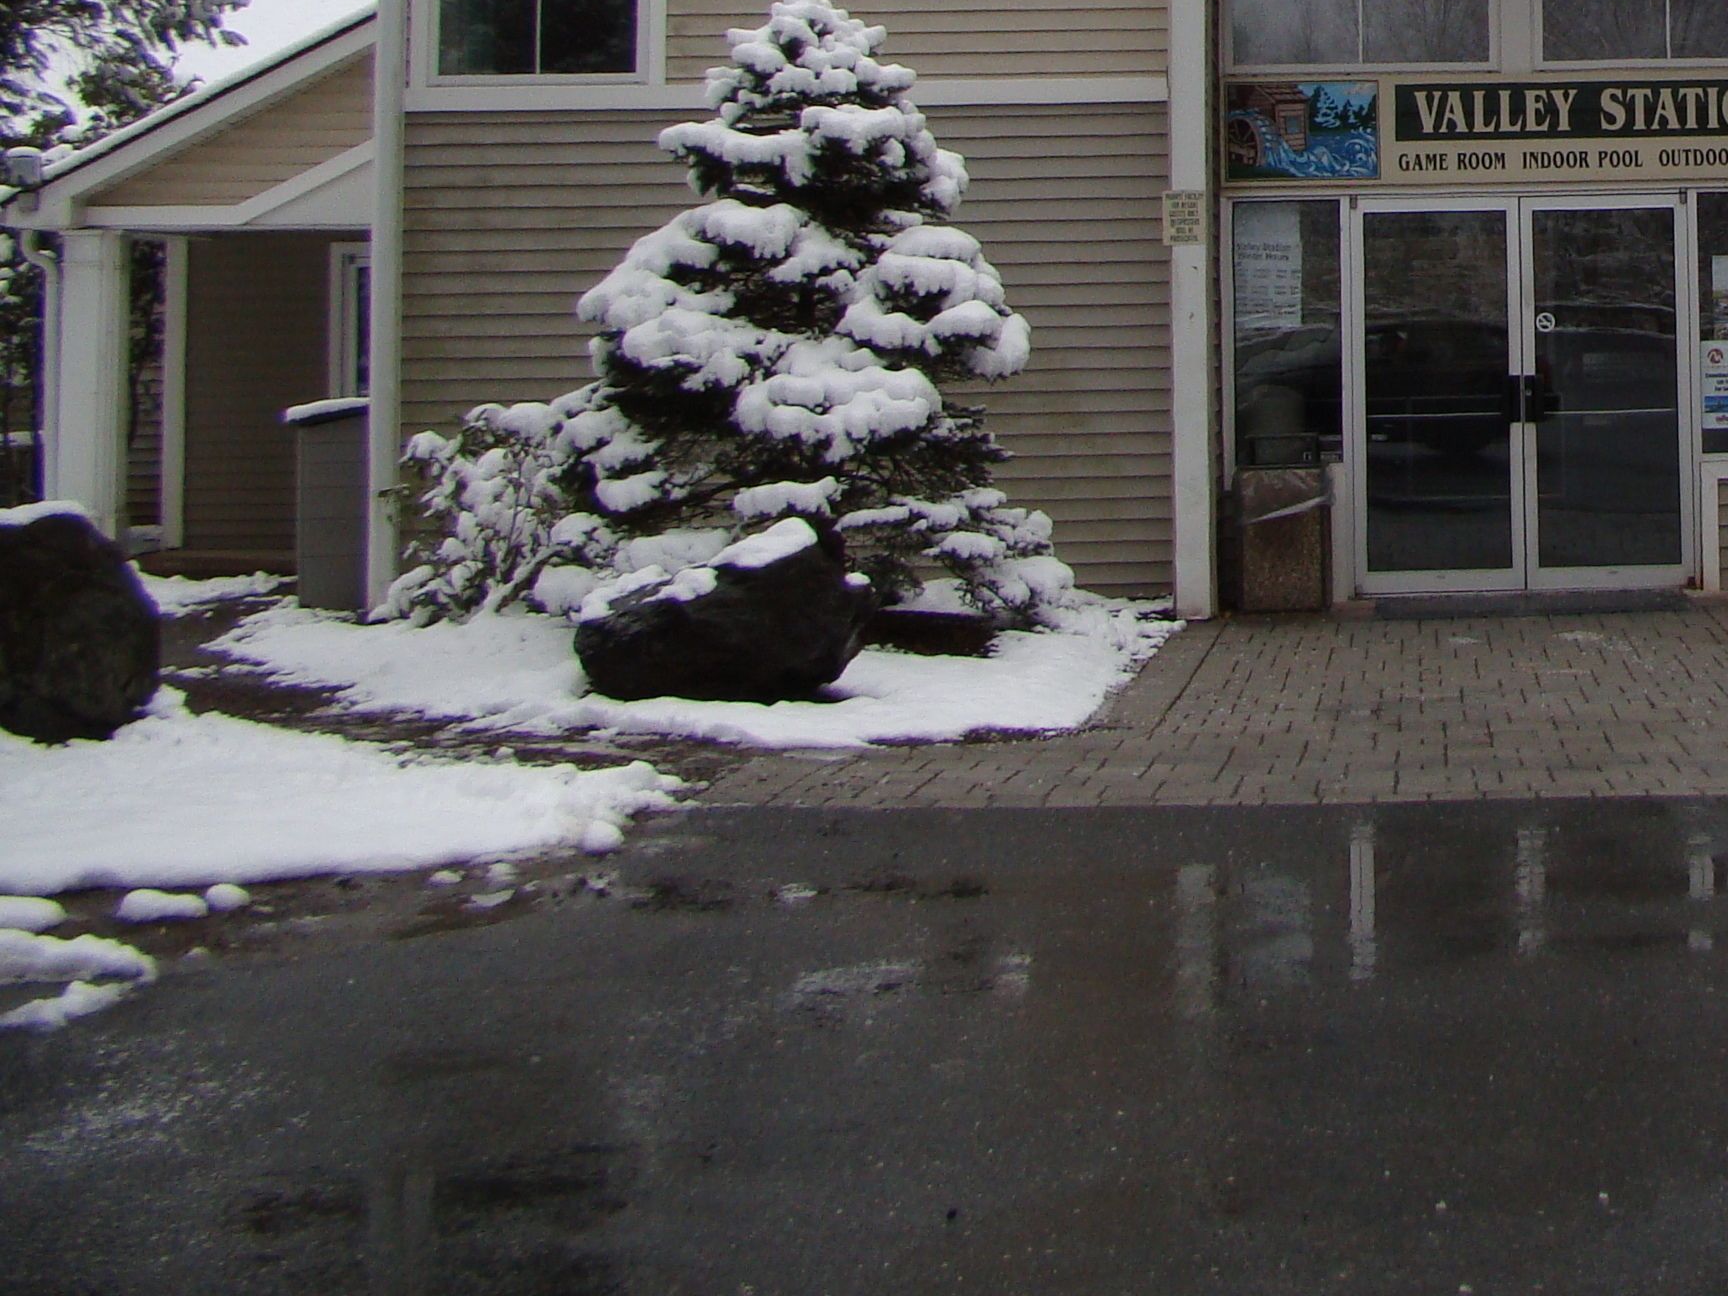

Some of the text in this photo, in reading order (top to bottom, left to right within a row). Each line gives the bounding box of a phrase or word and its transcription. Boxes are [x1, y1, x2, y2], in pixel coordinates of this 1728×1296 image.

[1413, 88, 1578, 134] VALLEY
[1398, 153, 1448, 171] GAME
[1457, 152, 1506, 170] ROOM
[1522, 150, 1590, 169] INDOOR
[1598, 150, 1643, 168] POOL
